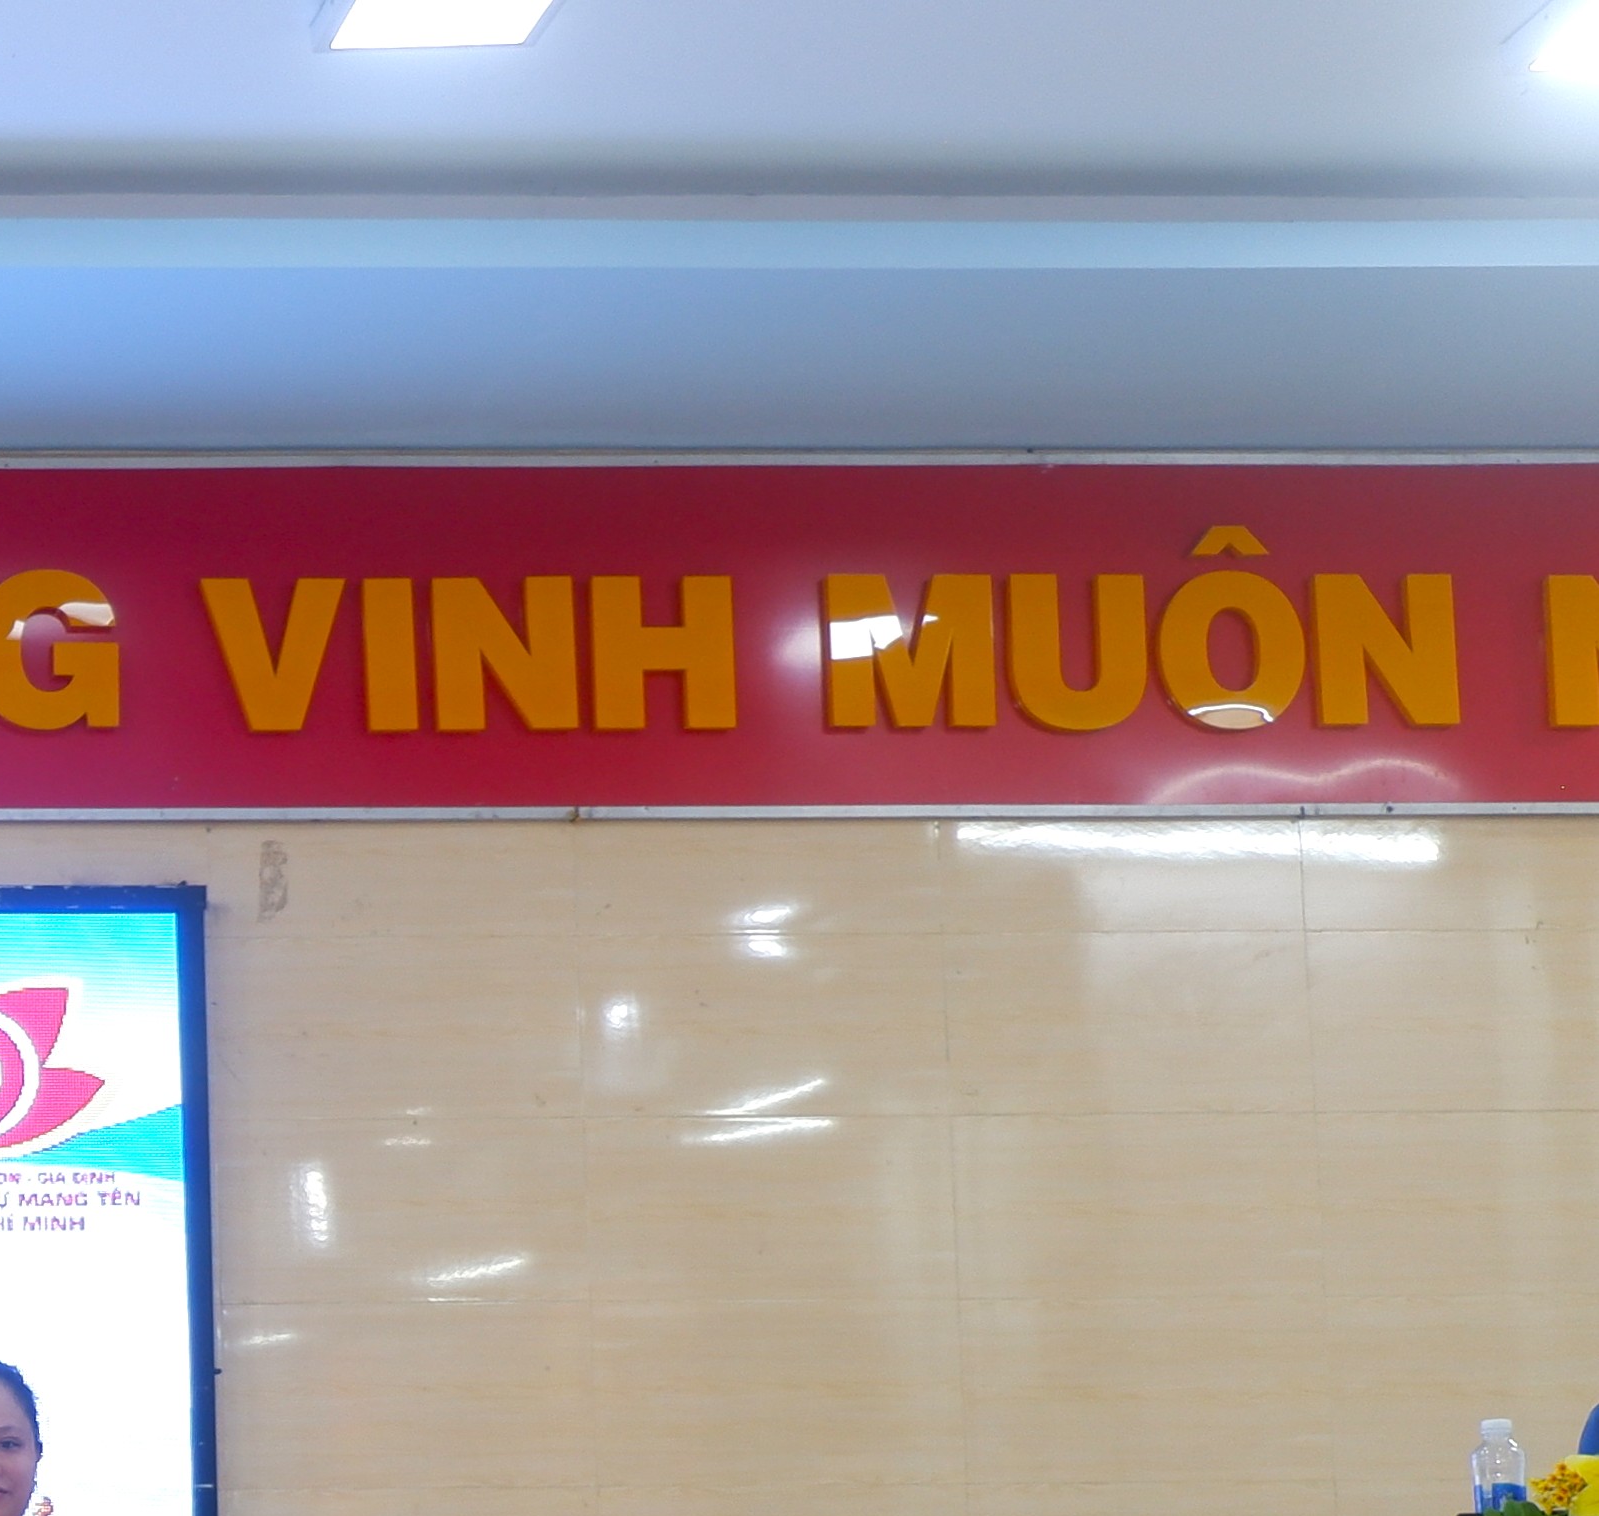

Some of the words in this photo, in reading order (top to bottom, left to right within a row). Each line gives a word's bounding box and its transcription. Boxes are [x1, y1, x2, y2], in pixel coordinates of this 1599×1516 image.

[202, 575, 738, 733] VINH
[822, 525, 1461, 731] MUÔN
[18, 1192, 88, 1207] MANG
[22, 1216, 85, 1232] MINH
